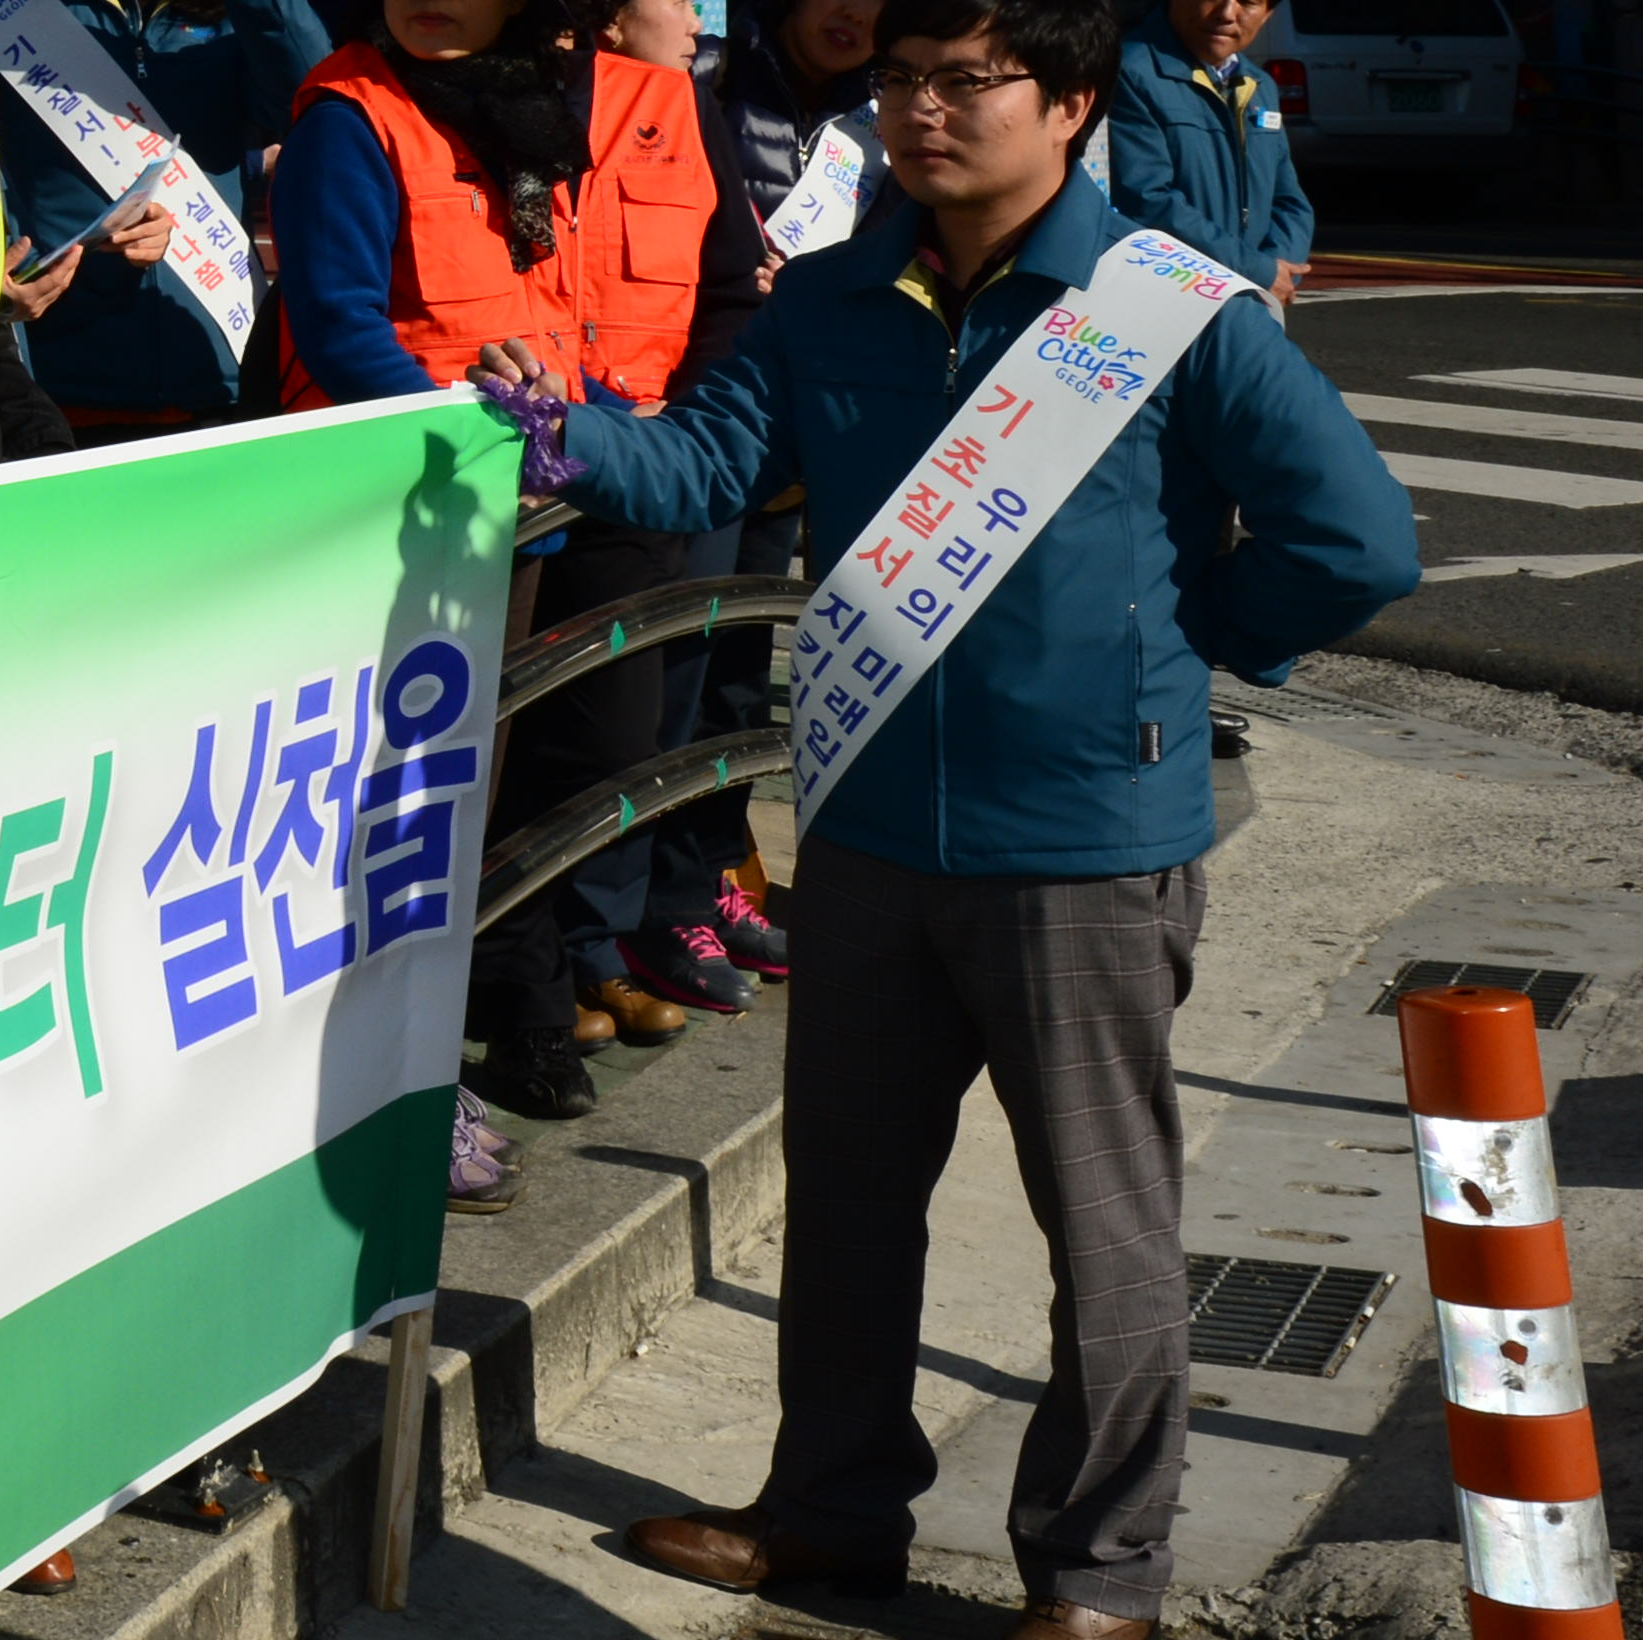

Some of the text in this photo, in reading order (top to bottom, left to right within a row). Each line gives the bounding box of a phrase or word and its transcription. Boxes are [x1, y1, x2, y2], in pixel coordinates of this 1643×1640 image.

[1036, 336, 1108, 381] City
[1043, 306, 1118, 356] Blue
[1053, 366, 1105, 404] GEOJE
[855, 383, 1035, 589] 기초질서
[794, 486, 1029, 816] 우리의 미래입니
[141, 640, 479, 1053] 실천을
